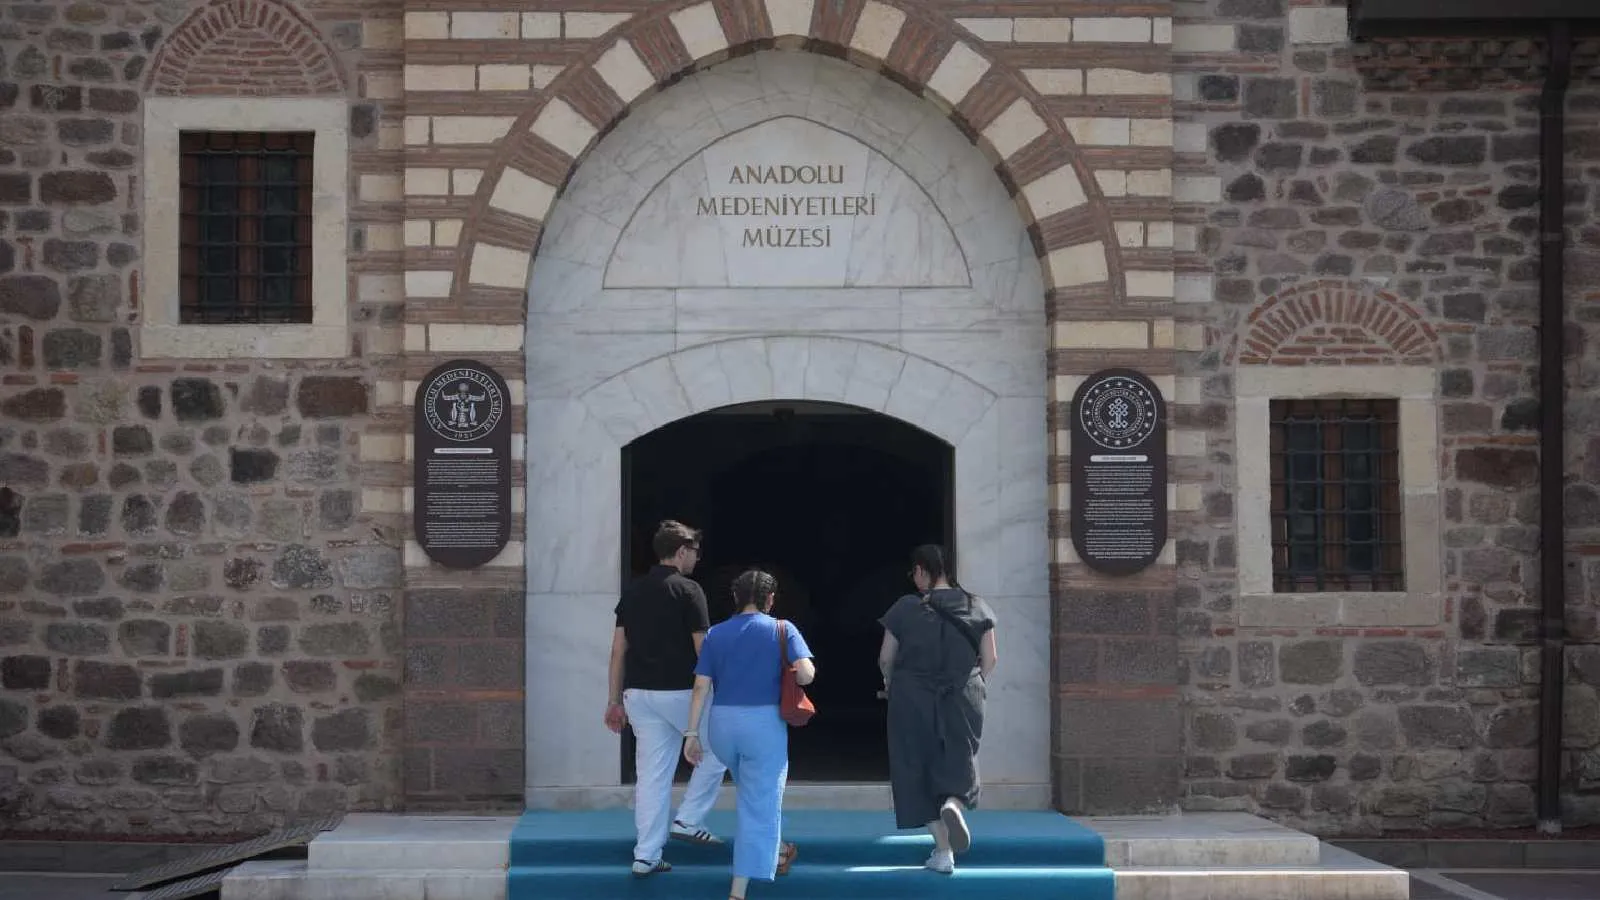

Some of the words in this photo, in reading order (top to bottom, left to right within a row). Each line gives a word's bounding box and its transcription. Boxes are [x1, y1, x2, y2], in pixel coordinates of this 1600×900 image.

[729, 165, 843, 184] ANADOLU
[696, 193, 876, 216] MEDENİYETLERİ
[742, 225, 831, 247] MÜZESİ
